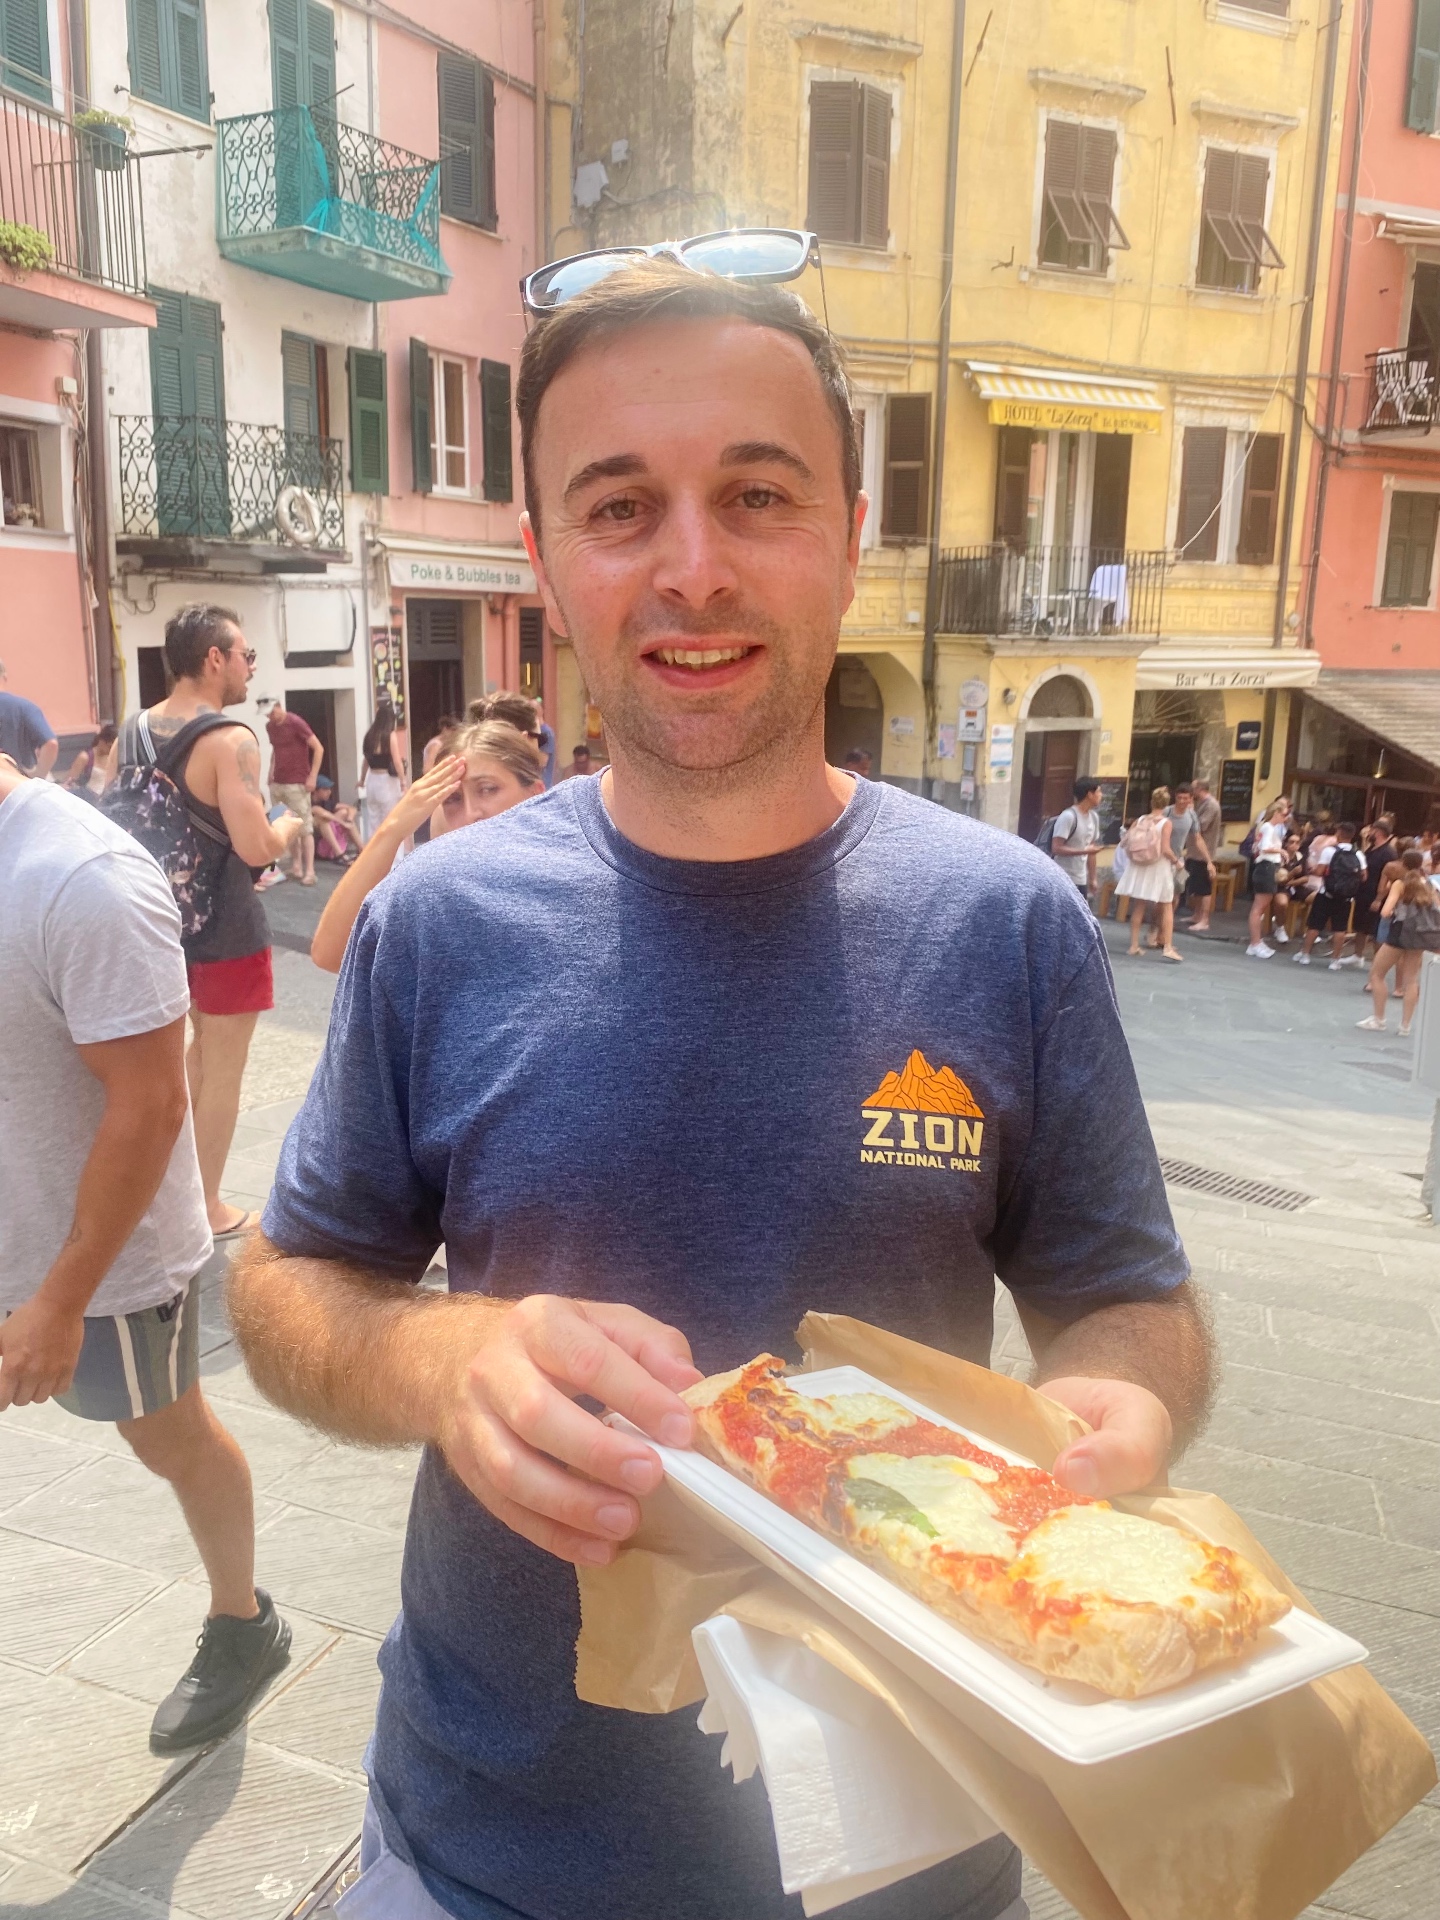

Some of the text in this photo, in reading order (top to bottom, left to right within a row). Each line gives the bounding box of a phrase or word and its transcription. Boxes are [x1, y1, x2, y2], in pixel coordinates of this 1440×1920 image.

[1004, 404, 1042, 422] HOTEL
[411, 563, 521, 584] Poke & Bubbles tea
[1175, 671, 1273, 687] Bar "La Zorza"
[861, 1109, 984, 1156] ZION
[860, 1149, 982, 1172] NATIONAL PARK
